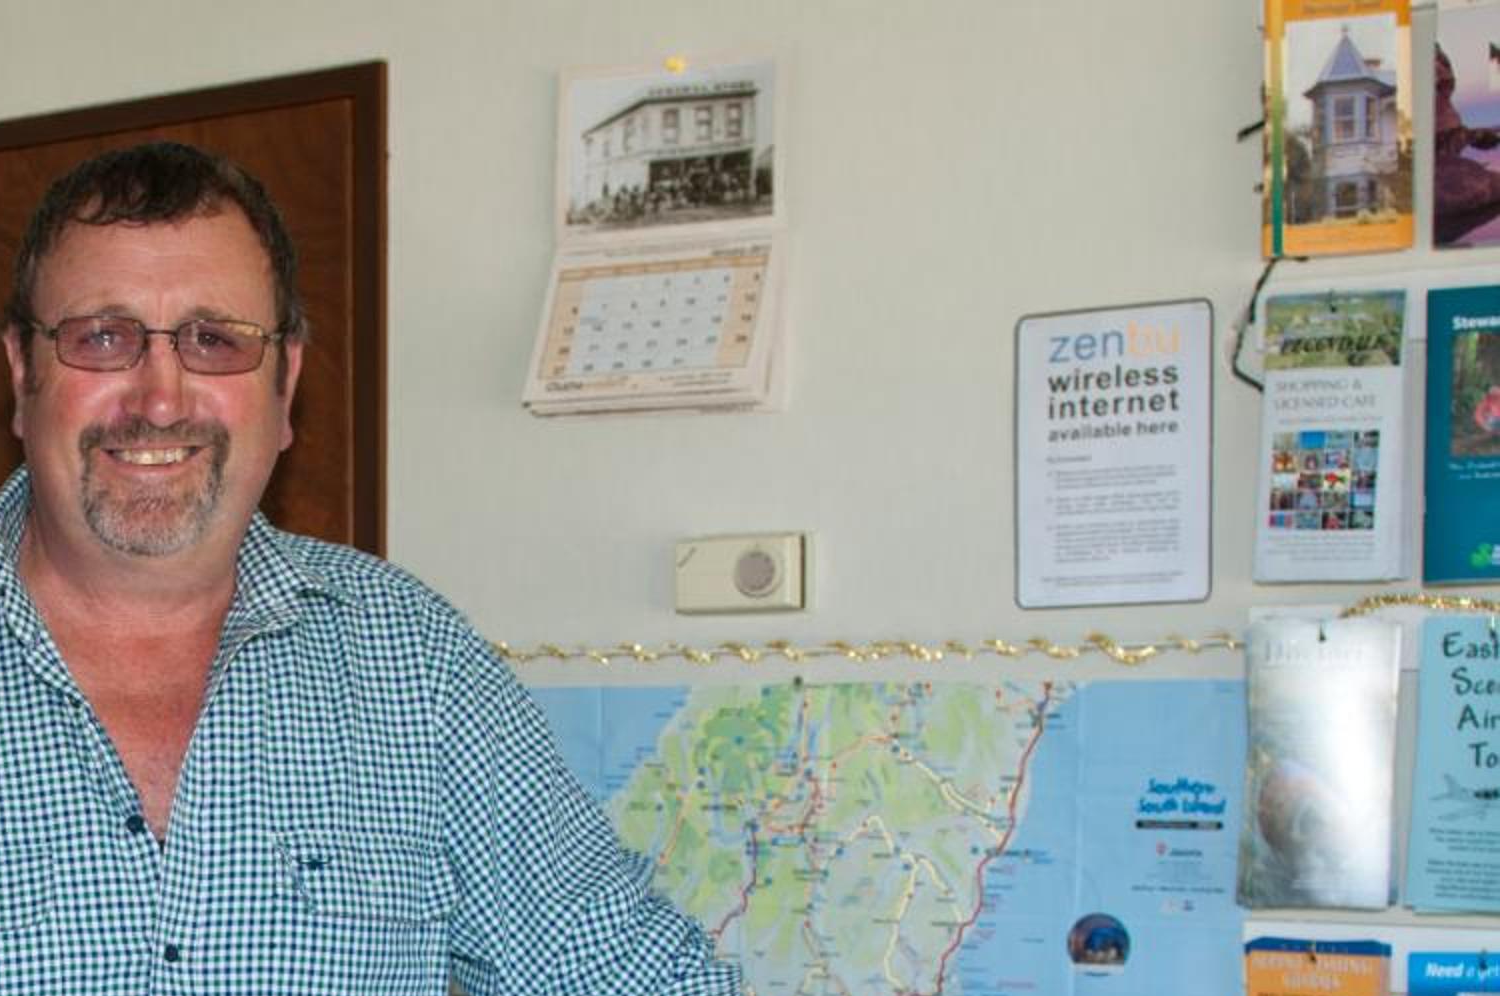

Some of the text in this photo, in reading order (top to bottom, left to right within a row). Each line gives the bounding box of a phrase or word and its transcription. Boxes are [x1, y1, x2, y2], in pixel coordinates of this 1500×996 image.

[1047, 364, 1180, 394] wireless
[1048, 388, 1181, 420] internet
[1048, 419, 1179, 443] available here
[1468, 741, 1499, 769] To
[1426, 962, 1464, 977] Need
